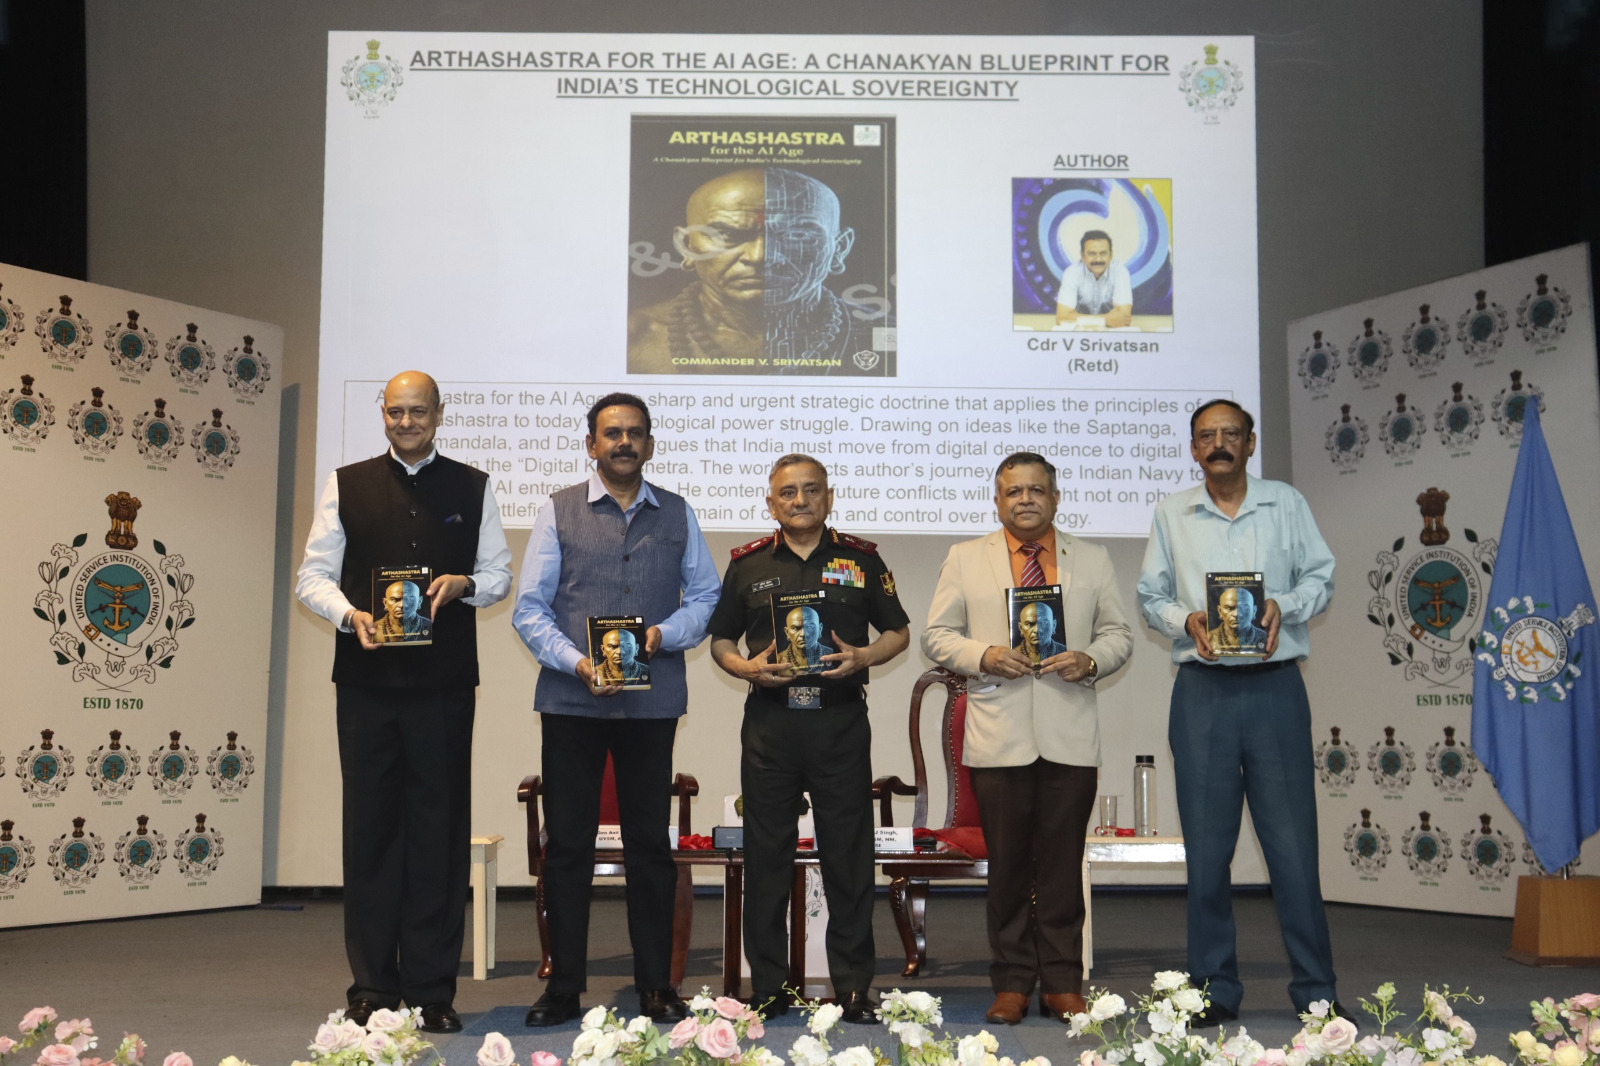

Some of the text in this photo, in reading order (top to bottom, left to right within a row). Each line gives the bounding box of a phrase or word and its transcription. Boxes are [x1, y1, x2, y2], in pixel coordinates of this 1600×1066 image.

[410, 50, 1169, 72] ARTHASHASTRA FOR THE AI AGE: A CHANAKYAN BLUEPRINT FOR
[557, 78, 1019, 97] INDIA'S TECHNOLOGICAL SOVEREIGNTY
[669, 131, 845, 145] ARTHASHASTRA
[710, 146, 804, 157] for the AI Age
[1053, 154, 1129, 168] AUTHOR
[1027, 338, 1159, 352] Cdr V Srivatsan
[672, 357, 754, 366] COMMANDER
[772, 358, 841, 366] SRIVATSAN
[1068, 358, 1119, 374] (Retd)
[491, 391, 513, 405] for
[520, 392, 545, 405] the
[550, 392, 567, 406] AI
[648, 392, 696, 410] sharp
[702, 394, 733, 408] and
[740, 394, 795, 412] urgent
[800, 394, 874, 412] strategic
[880, 395, 949, 410] doctrine
[955, 396, 988, 410] that
[994, 396, 1056, 414] applies
[1062, 397, 1088, 412] the
[1095, 398, 1178, 416] principles
[514, 414, 530, 428] to
[536, 414, 588, 431] today'
[650, 416, 715, 432] ological
[722, 420, 774, 433] power
[780, 416, 853, 434] struggle.
[861, 417, 931, 436] Drawing
[938, 420, 959, 433] on
[966, 418, 1012, 434] ideas
[1018, 418, 1048, 434] like
[1053, 420, 1080, 434] the
[1087, 420, 1176, 438] Saptanga,
[518, 436, 550, 450] and
[654, 441, 698, 455] gues
[704, 438, 737, 452] that
[743, 438, 784, 453] India
[790, 440, 832, 454] must
[838, 442, 886, 454] move
[892, 440, 930, 455] from
[936, 440, 987, 458] digital
[994, 441, 1102, 458] dependence
[1108, 444, 1124, 458] to
[1130, 443, 1182, 462] digital
[486, 458, 512, 472] the
[700, 460, 732, 474] The
[854, 462, 924, 477] author's
[930, 464, 994, 481] journey
[1080, 466, 1132, 480] Indian
[1139, 466, 1184, 484] Navy
[1190, 467, 1206, 481] to
[494, 480, 512, 494] AI
[678, 482, 702, 497] He
[708, 484, 771, 498] conten
[886, 484, 957, 500] conflicts
[962, 486, 990, 500] will
[1085, 488, 1112, 502] not
[1118, 490, 1139, 503] on
[694, 506, 732, 520] main
[739, 506, 756, 520] of
[845, 508, 877, 522] and
[884, 508, 942, 522] control
[948, 511, 986, 524] over
[74, 554, 160, 626] UNITED SERVICE INSTITUTION OF INDIA
[1400, 550, 1478, 620] UNITED SERVICE INSTITUTION OF INDIA
[83, 697, 144, 710] ESTD 1870
[1416, 694, 1472, 706] ESTD 1870
